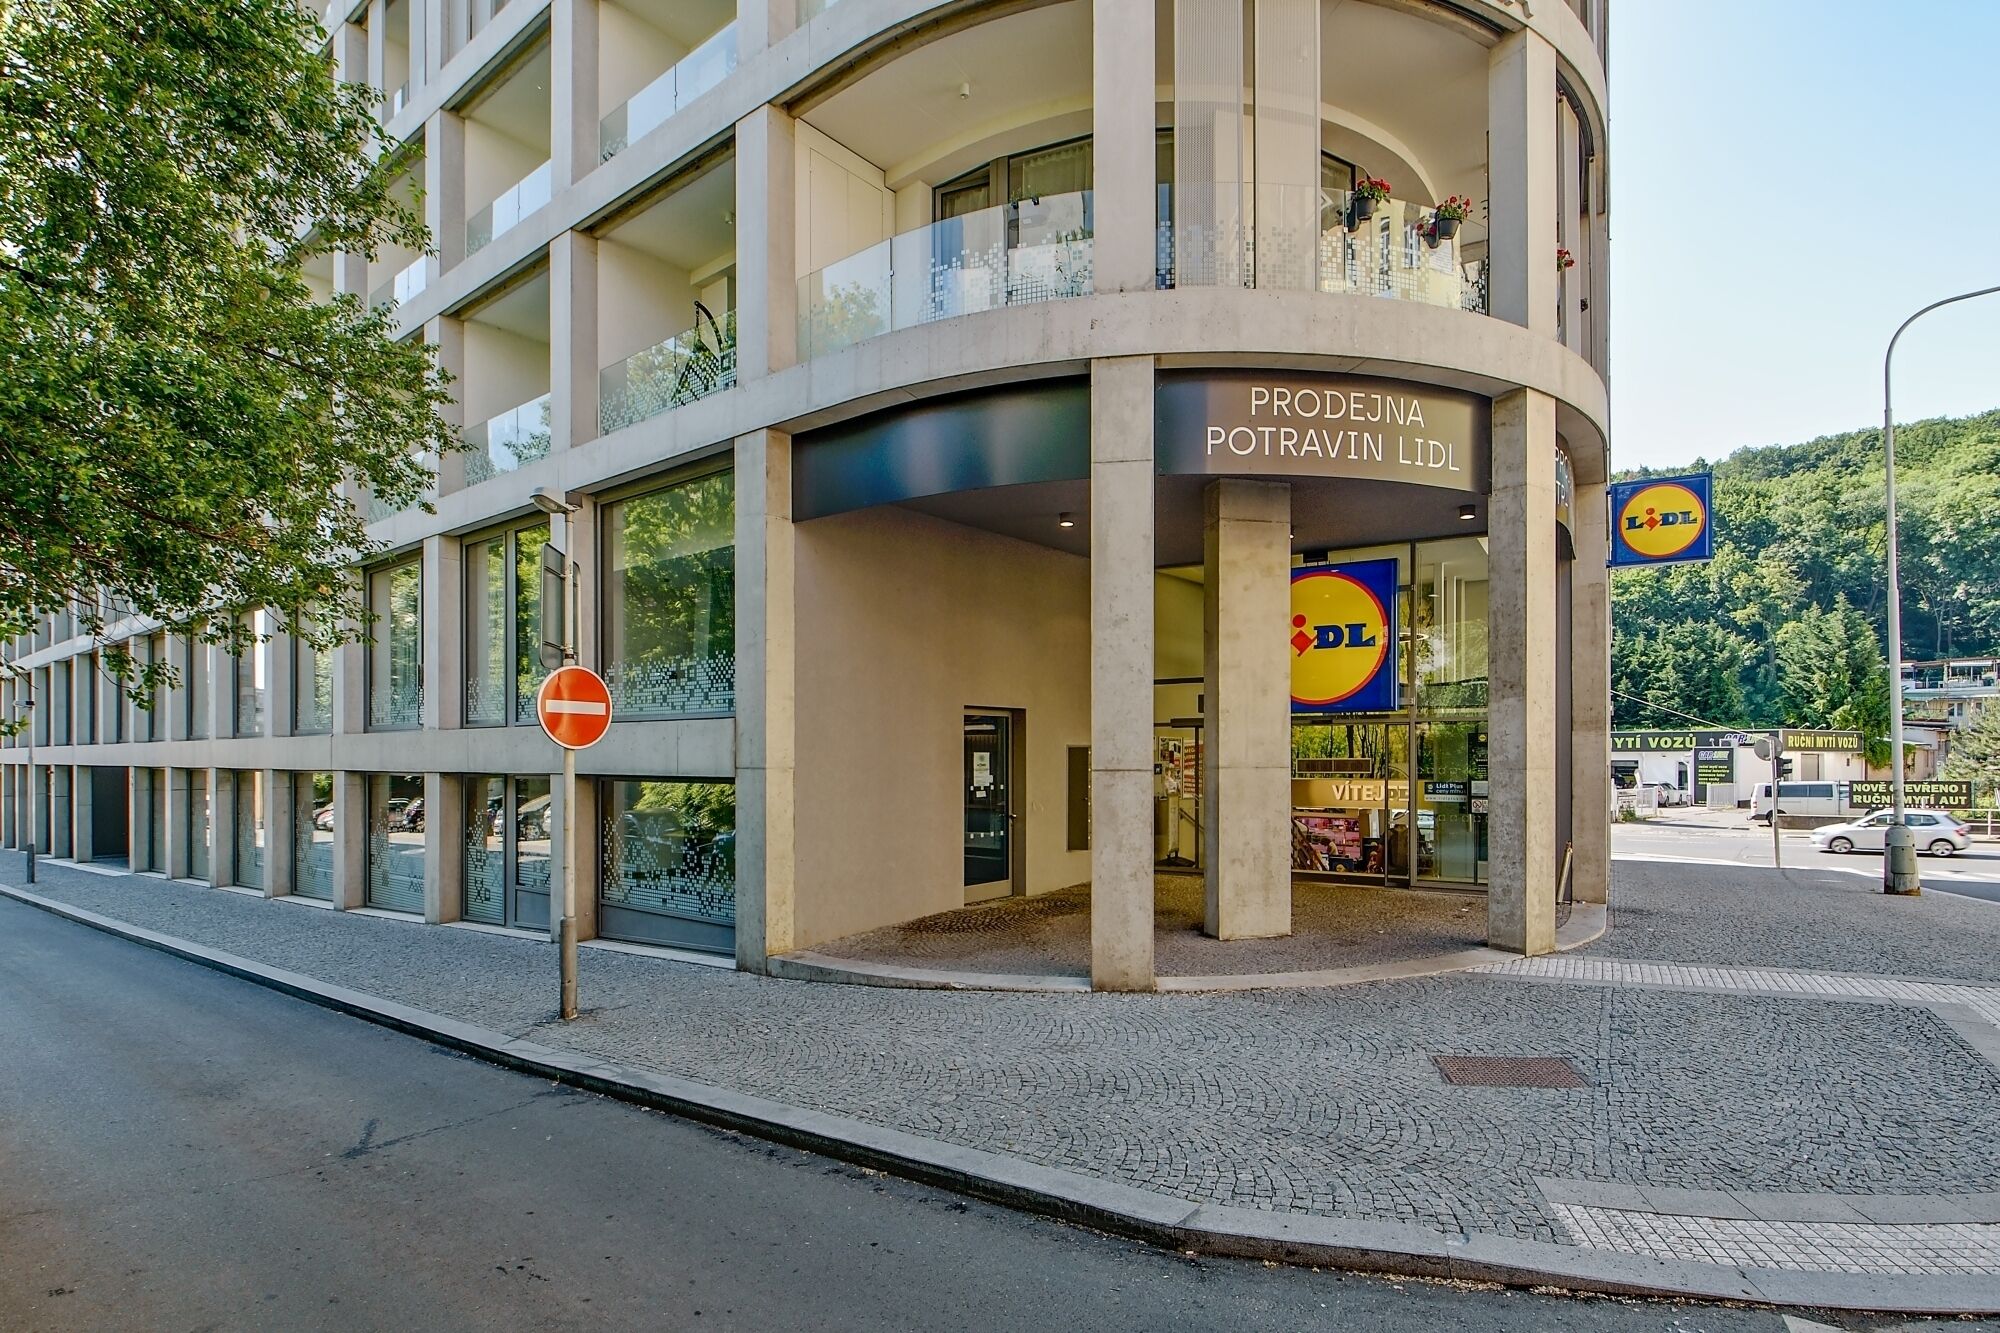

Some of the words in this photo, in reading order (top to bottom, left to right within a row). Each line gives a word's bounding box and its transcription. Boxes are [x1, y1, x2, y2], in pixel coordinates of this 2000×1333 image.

[1250, 386, 1425, 428] PRODEJNA
[1206, 426, 1383, 462] POTRAVIN
[1398, 436, 1461, 471] LIDL
[1610, 735, 1641, 749] YTÍ
[1647, 733, 1697, 749] VOZŮ
[1788, 733, 1814, 748] RUČNÍ
[1816, 734, 1836, 748] MYTÍ
[1838, 734, 1858, 749] VOZŮ
[1853, 782, 1886, 792] NOVĚ
[1939, 796, 1968, 805] AUT
